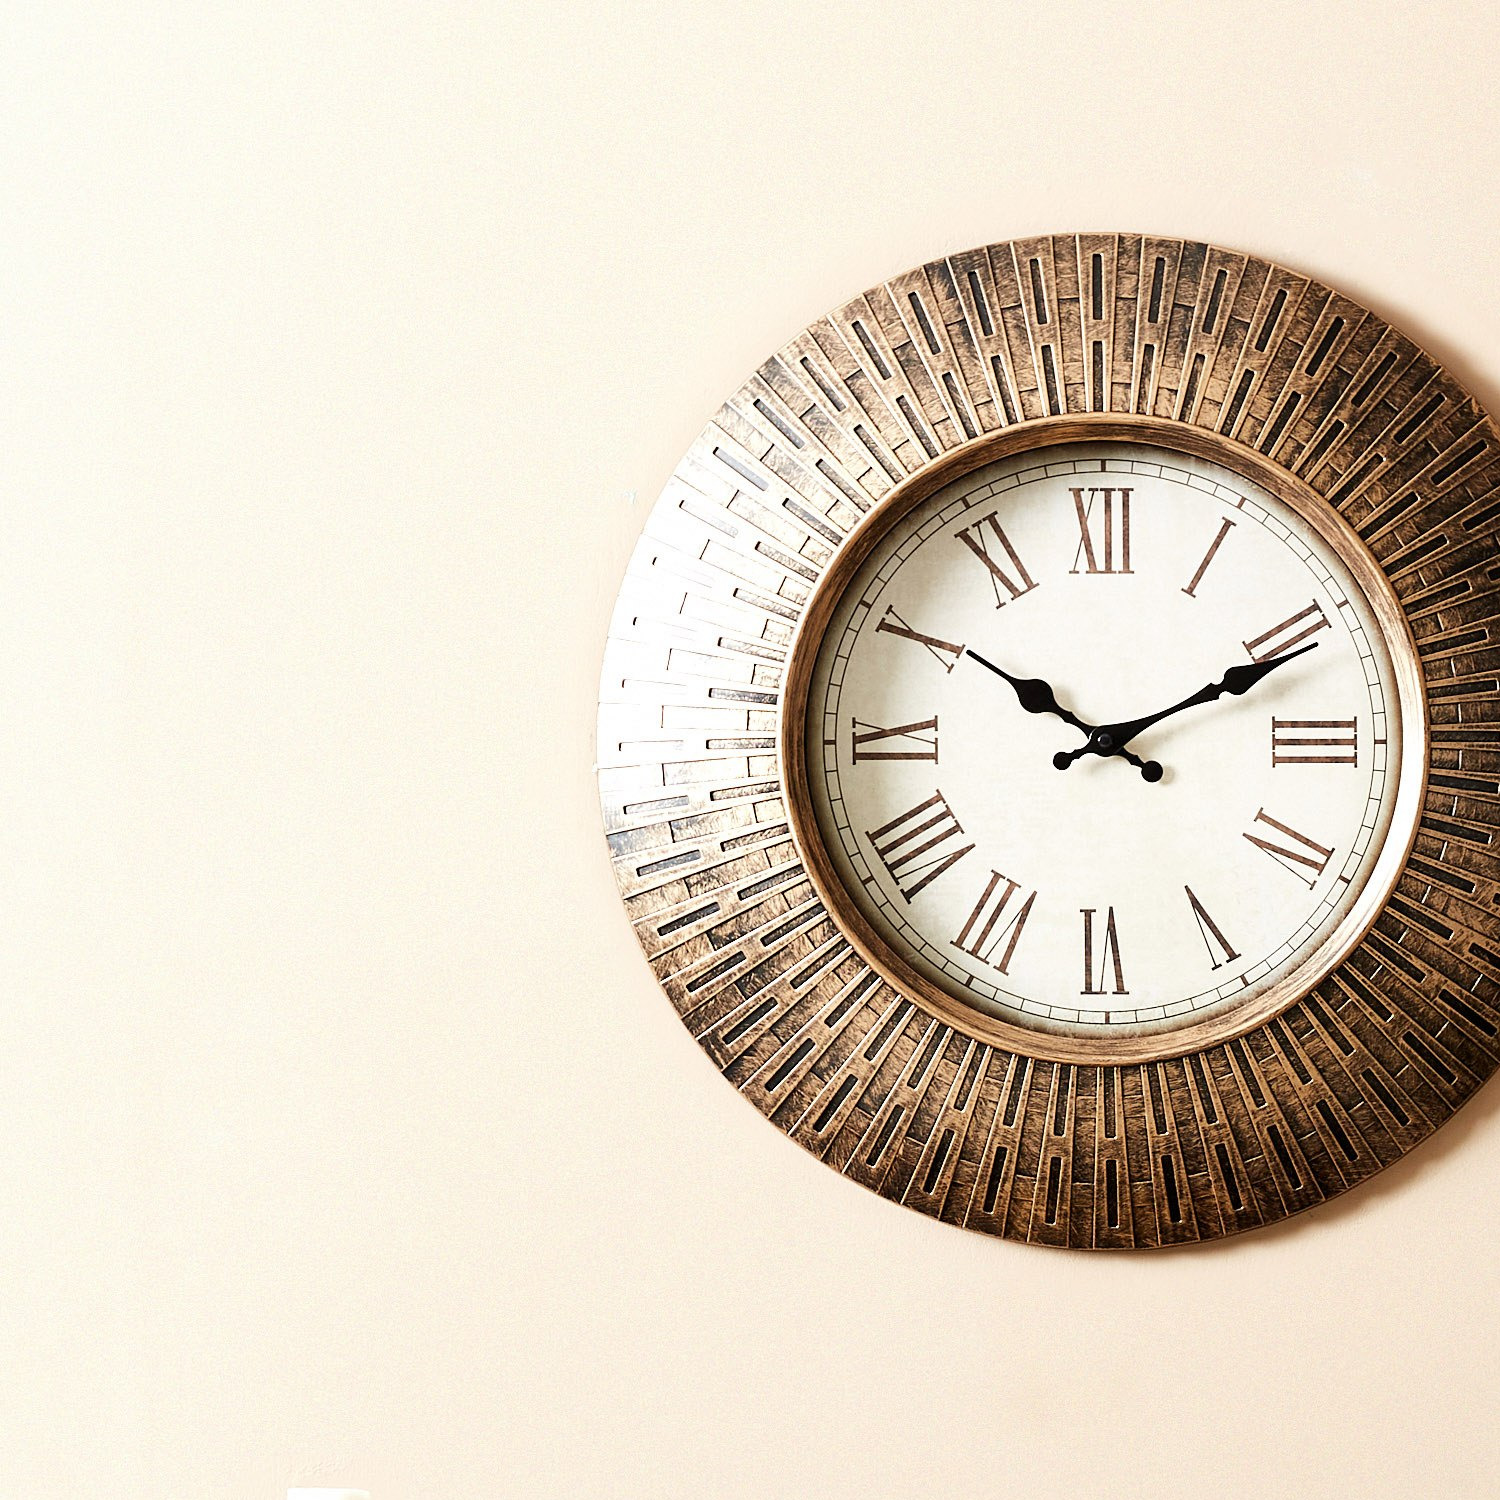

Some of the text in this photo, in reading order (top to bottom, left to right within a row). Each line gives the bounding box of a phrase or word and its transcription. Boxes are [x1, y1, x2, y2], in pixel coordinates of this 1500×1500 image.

[954, 510, 1040, 609] XI
[1069, 488, 1134, 574] XII
[1181, 517, 1237, 598] I
[875, 605, 965, 673] X
[1242, 598, 1332, 667] II
[852, 715, 938, 766] IX
[1272, 716, 1357, 768] III
[865, 790, 976, 904] VIII
[1243, 807, 1335, 890] IV
[950, 869, 1037, 976] VII
[1080, 906, 1129, 995] VI
[1185, 885, 1241, 971] V
